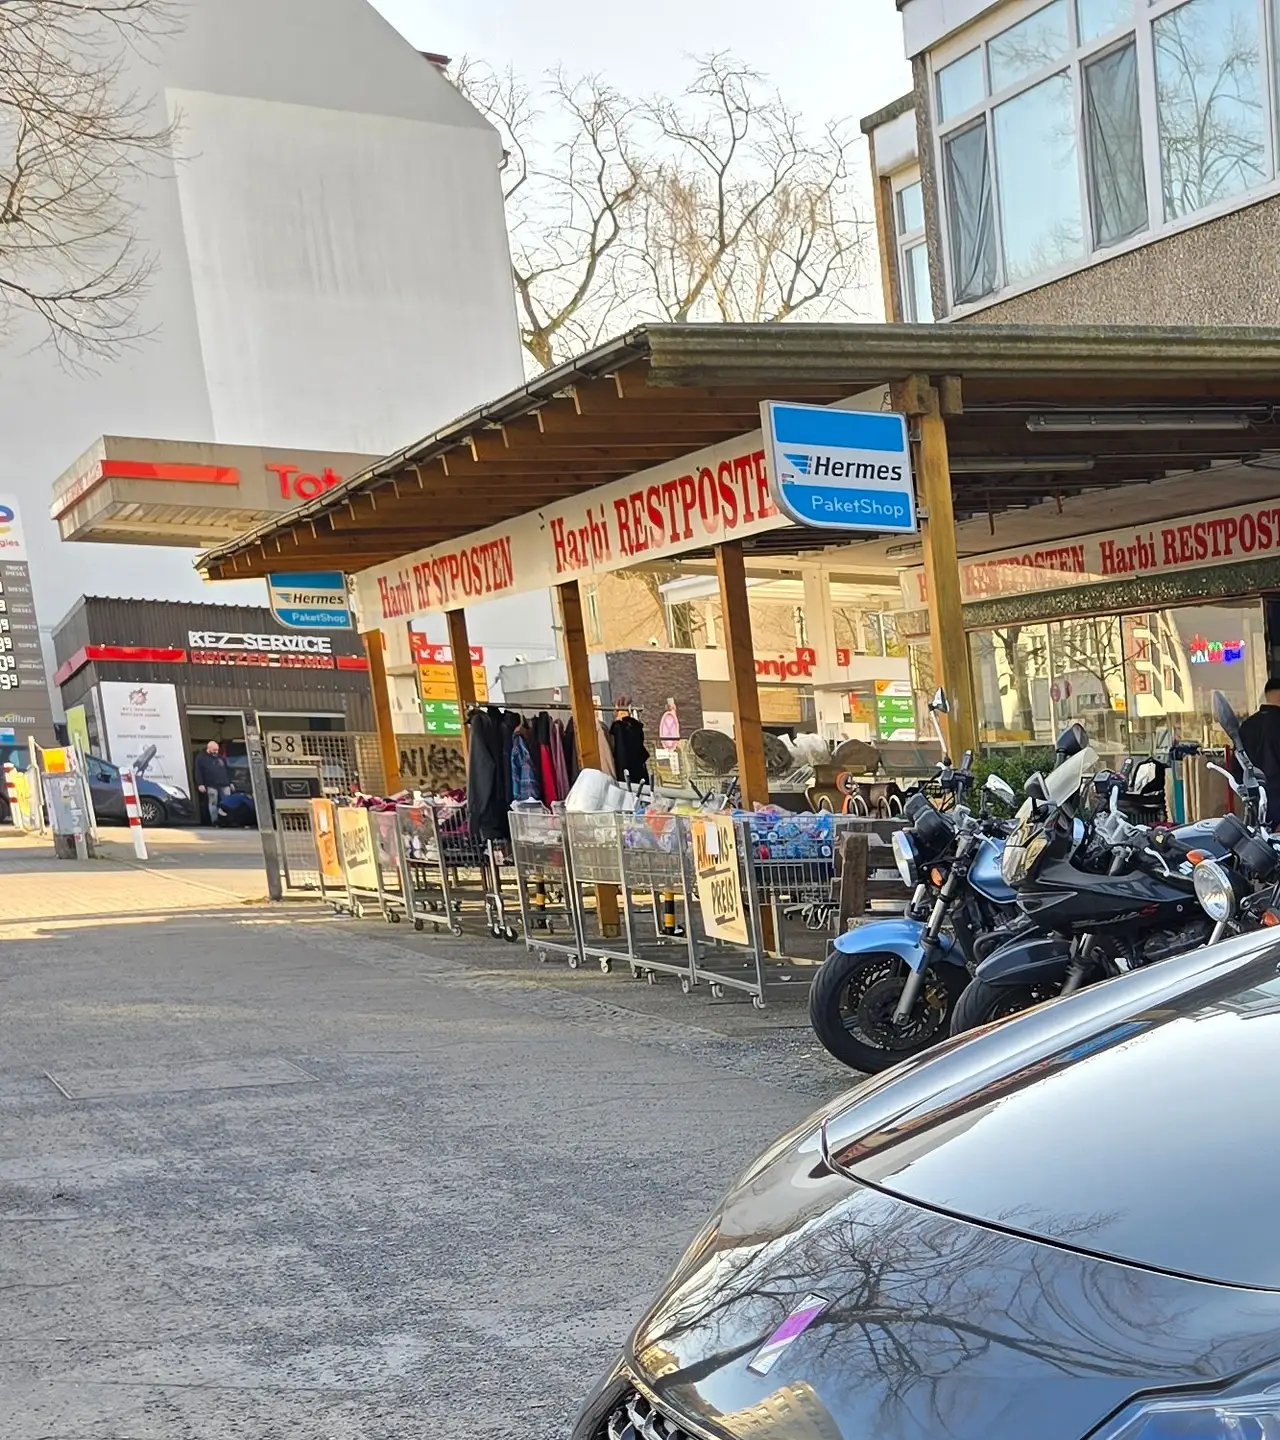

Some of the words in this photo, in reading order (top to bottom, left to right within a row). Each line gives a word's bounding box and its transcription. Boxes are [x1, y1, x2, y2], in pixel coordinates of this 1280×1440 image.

[814, 456, 902, 481] Hermes
[550, 504, 612, 573] Harbi
[613, 449, 782, 557] RESTPOSTE
[812, 495, 904, 518] PaketShop
[1099, 532, 1157, 575] Harbi
[377, 568, 414, 618] Harbi
[413, 536, 514, 610] RESTPOSTEN
[293, 593, 344, 604] Hermes
[292, 612, 346, 623] PaketShop
[243, 634, 332, 653] SERVICE
[271, 735, 295, 752] 58
[711, 870, 739, 918] PREIS!
